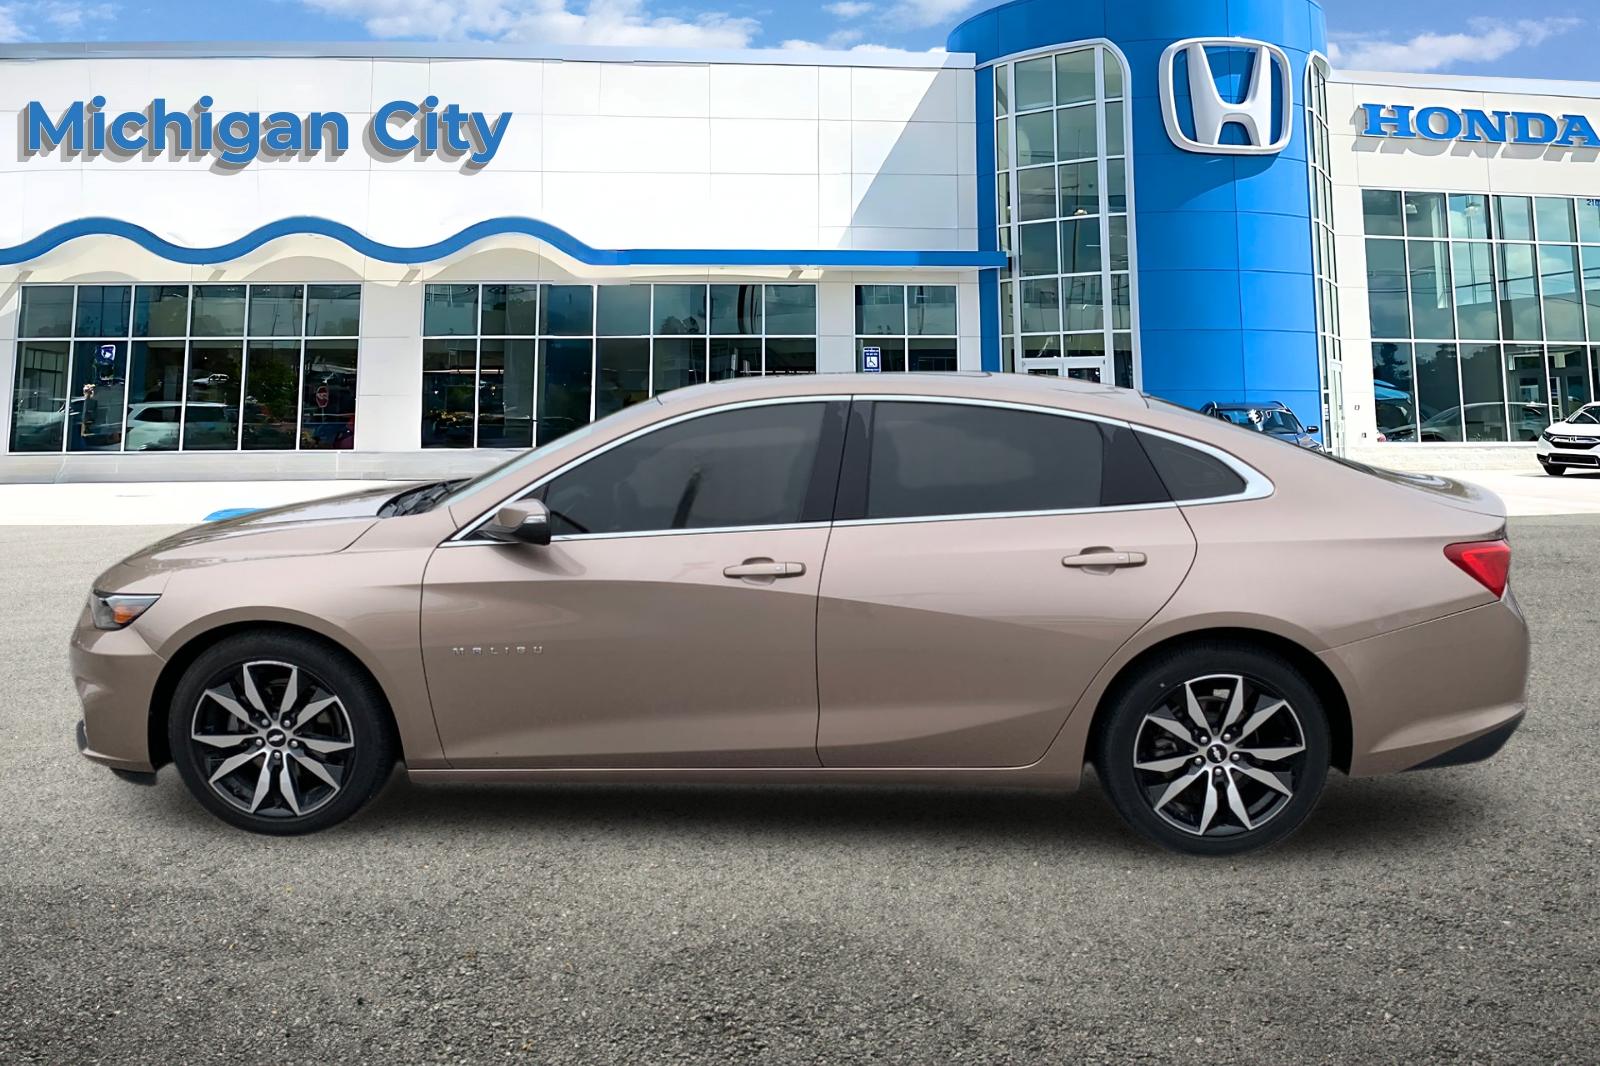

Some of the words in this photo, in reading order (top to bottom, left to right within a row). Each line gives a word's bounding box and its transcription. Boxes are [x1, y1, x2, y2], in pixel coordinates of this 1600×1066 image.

[27, 95, 350, 164] Michigan
[373, 95, 514, 164] City
[1361, 103, 1600, 147] HONDA
[452, 645, 543, 656] MALIBU
